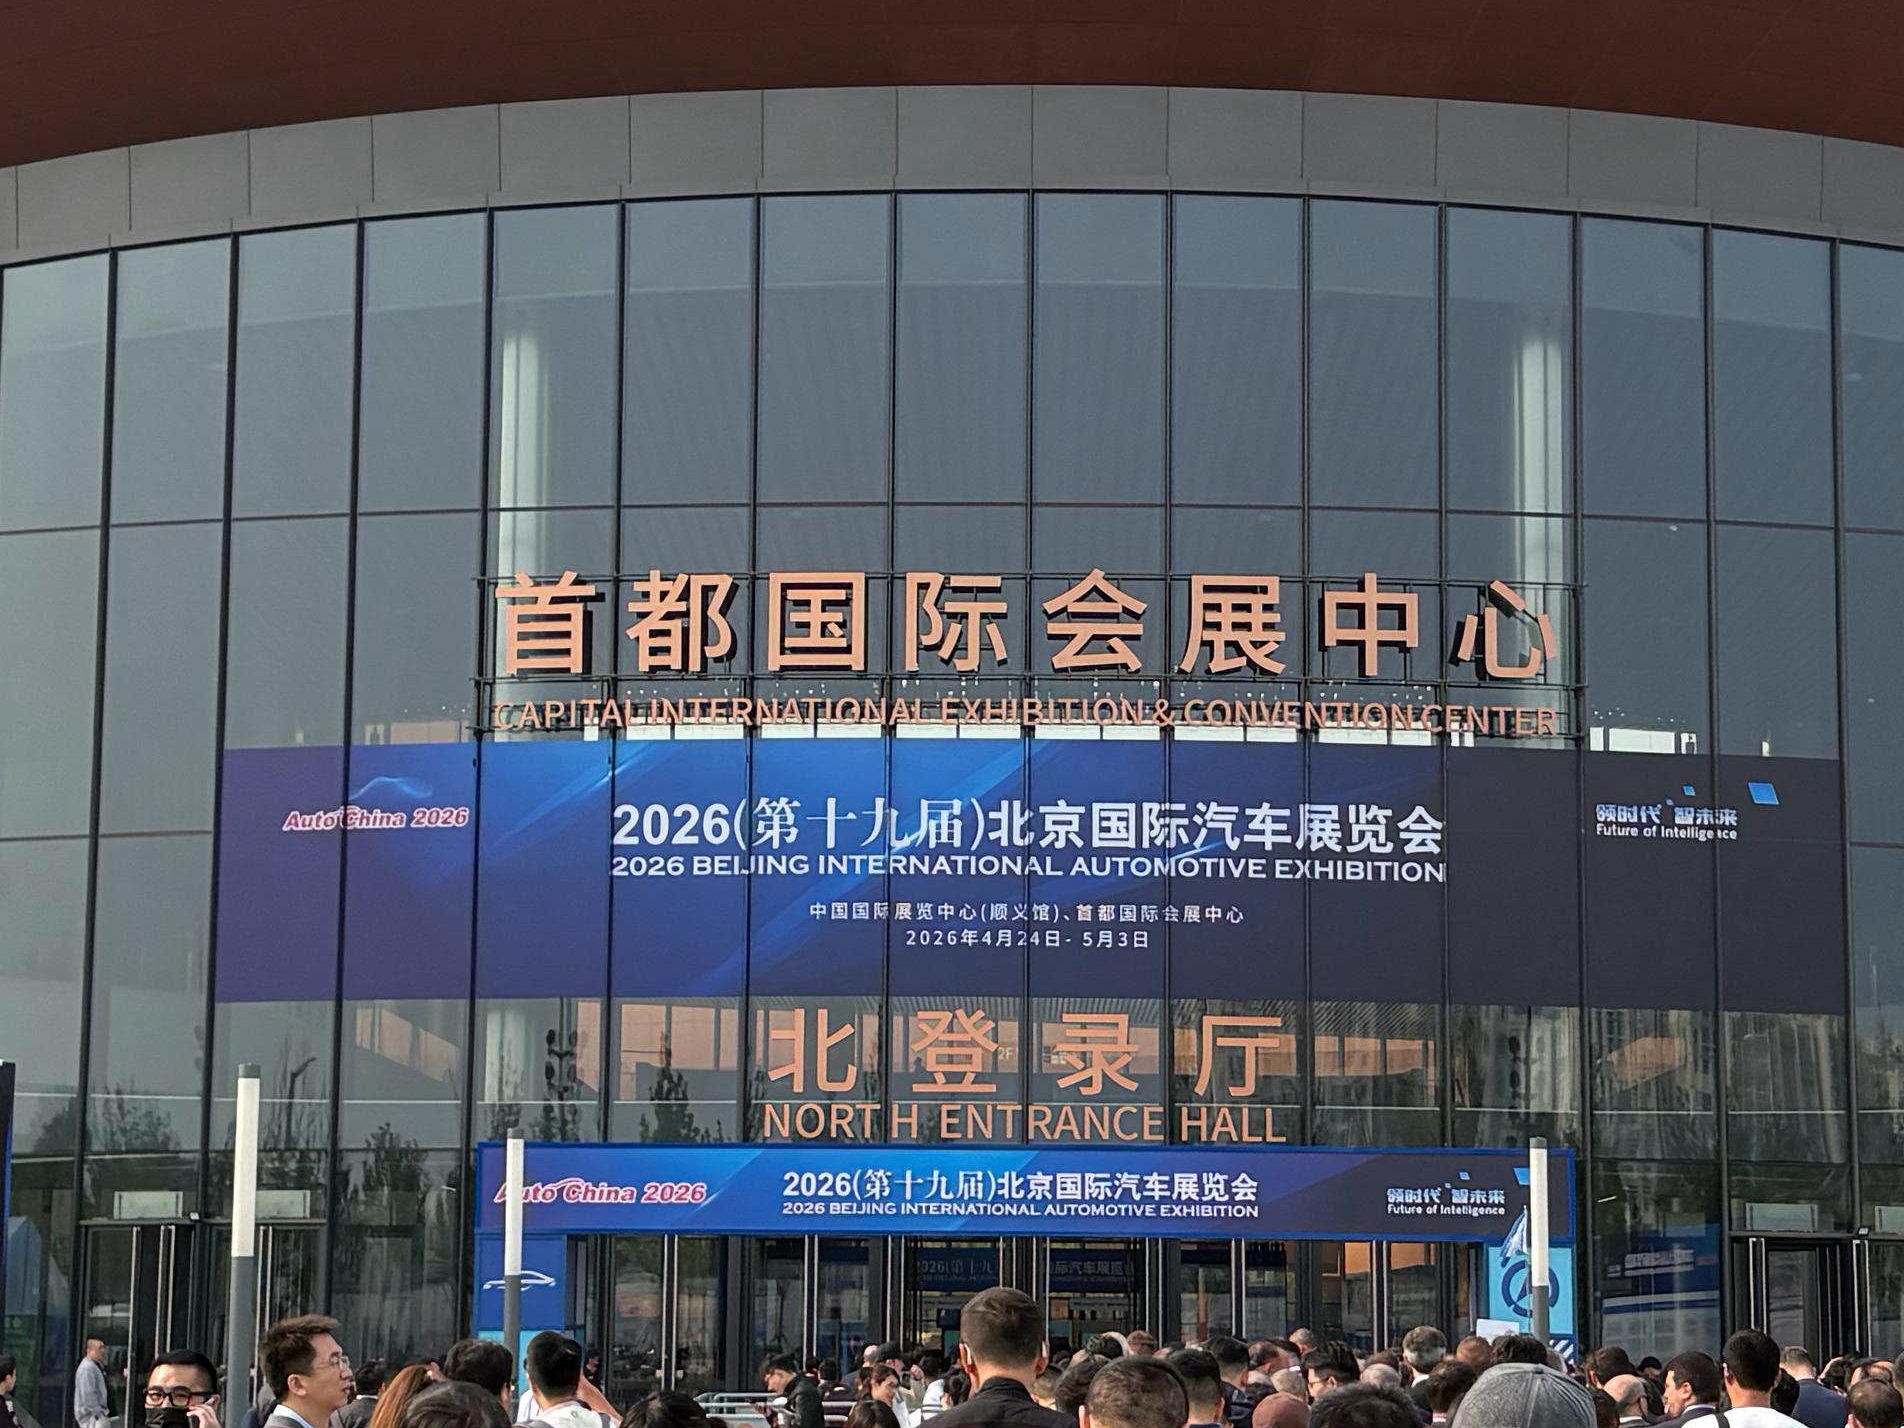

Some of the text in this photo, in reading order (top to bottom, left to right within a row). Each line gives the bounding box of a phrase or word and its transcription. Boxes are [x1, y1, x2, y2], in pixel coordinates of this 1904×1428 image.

[495, 568, 1558, 678] 首都国际会展中心
[494, 697, 1558, 736] CAPITAL INTERNATIONAL EXHIBITION & CONVENTION CENTER
[283, 805, 469, 831] Auto China 2026
[612, 796, 1444, 855] 2026(第十九届)北京国际汽车展览会
[1596, 823, 1639, 837] Future
[1643, 824, 1657, 837] of
[612, 854, 1447, 883] 2026 BEIJING INTERNATIONAL AUTOMOTIVE EXHIBITION
[768, 1008, 1281, 1097] 北登录厅
[764, 1103, 1287, 1143] NORTH ENTRANCE HALL
[562, 1178, 636, 1203] China
[641, 1182, 707, 1204] 2026
[783, 1170, 1259, 1202] 2026(第十九届)北京国际汽车展览会
[782, 1202, 1259, 1218] 2026 BEIJING INTERNATIONAL AUTOMOTIVE EXHIBITION
[1387, 1203, 1506, 1217] Future of Intelligence
